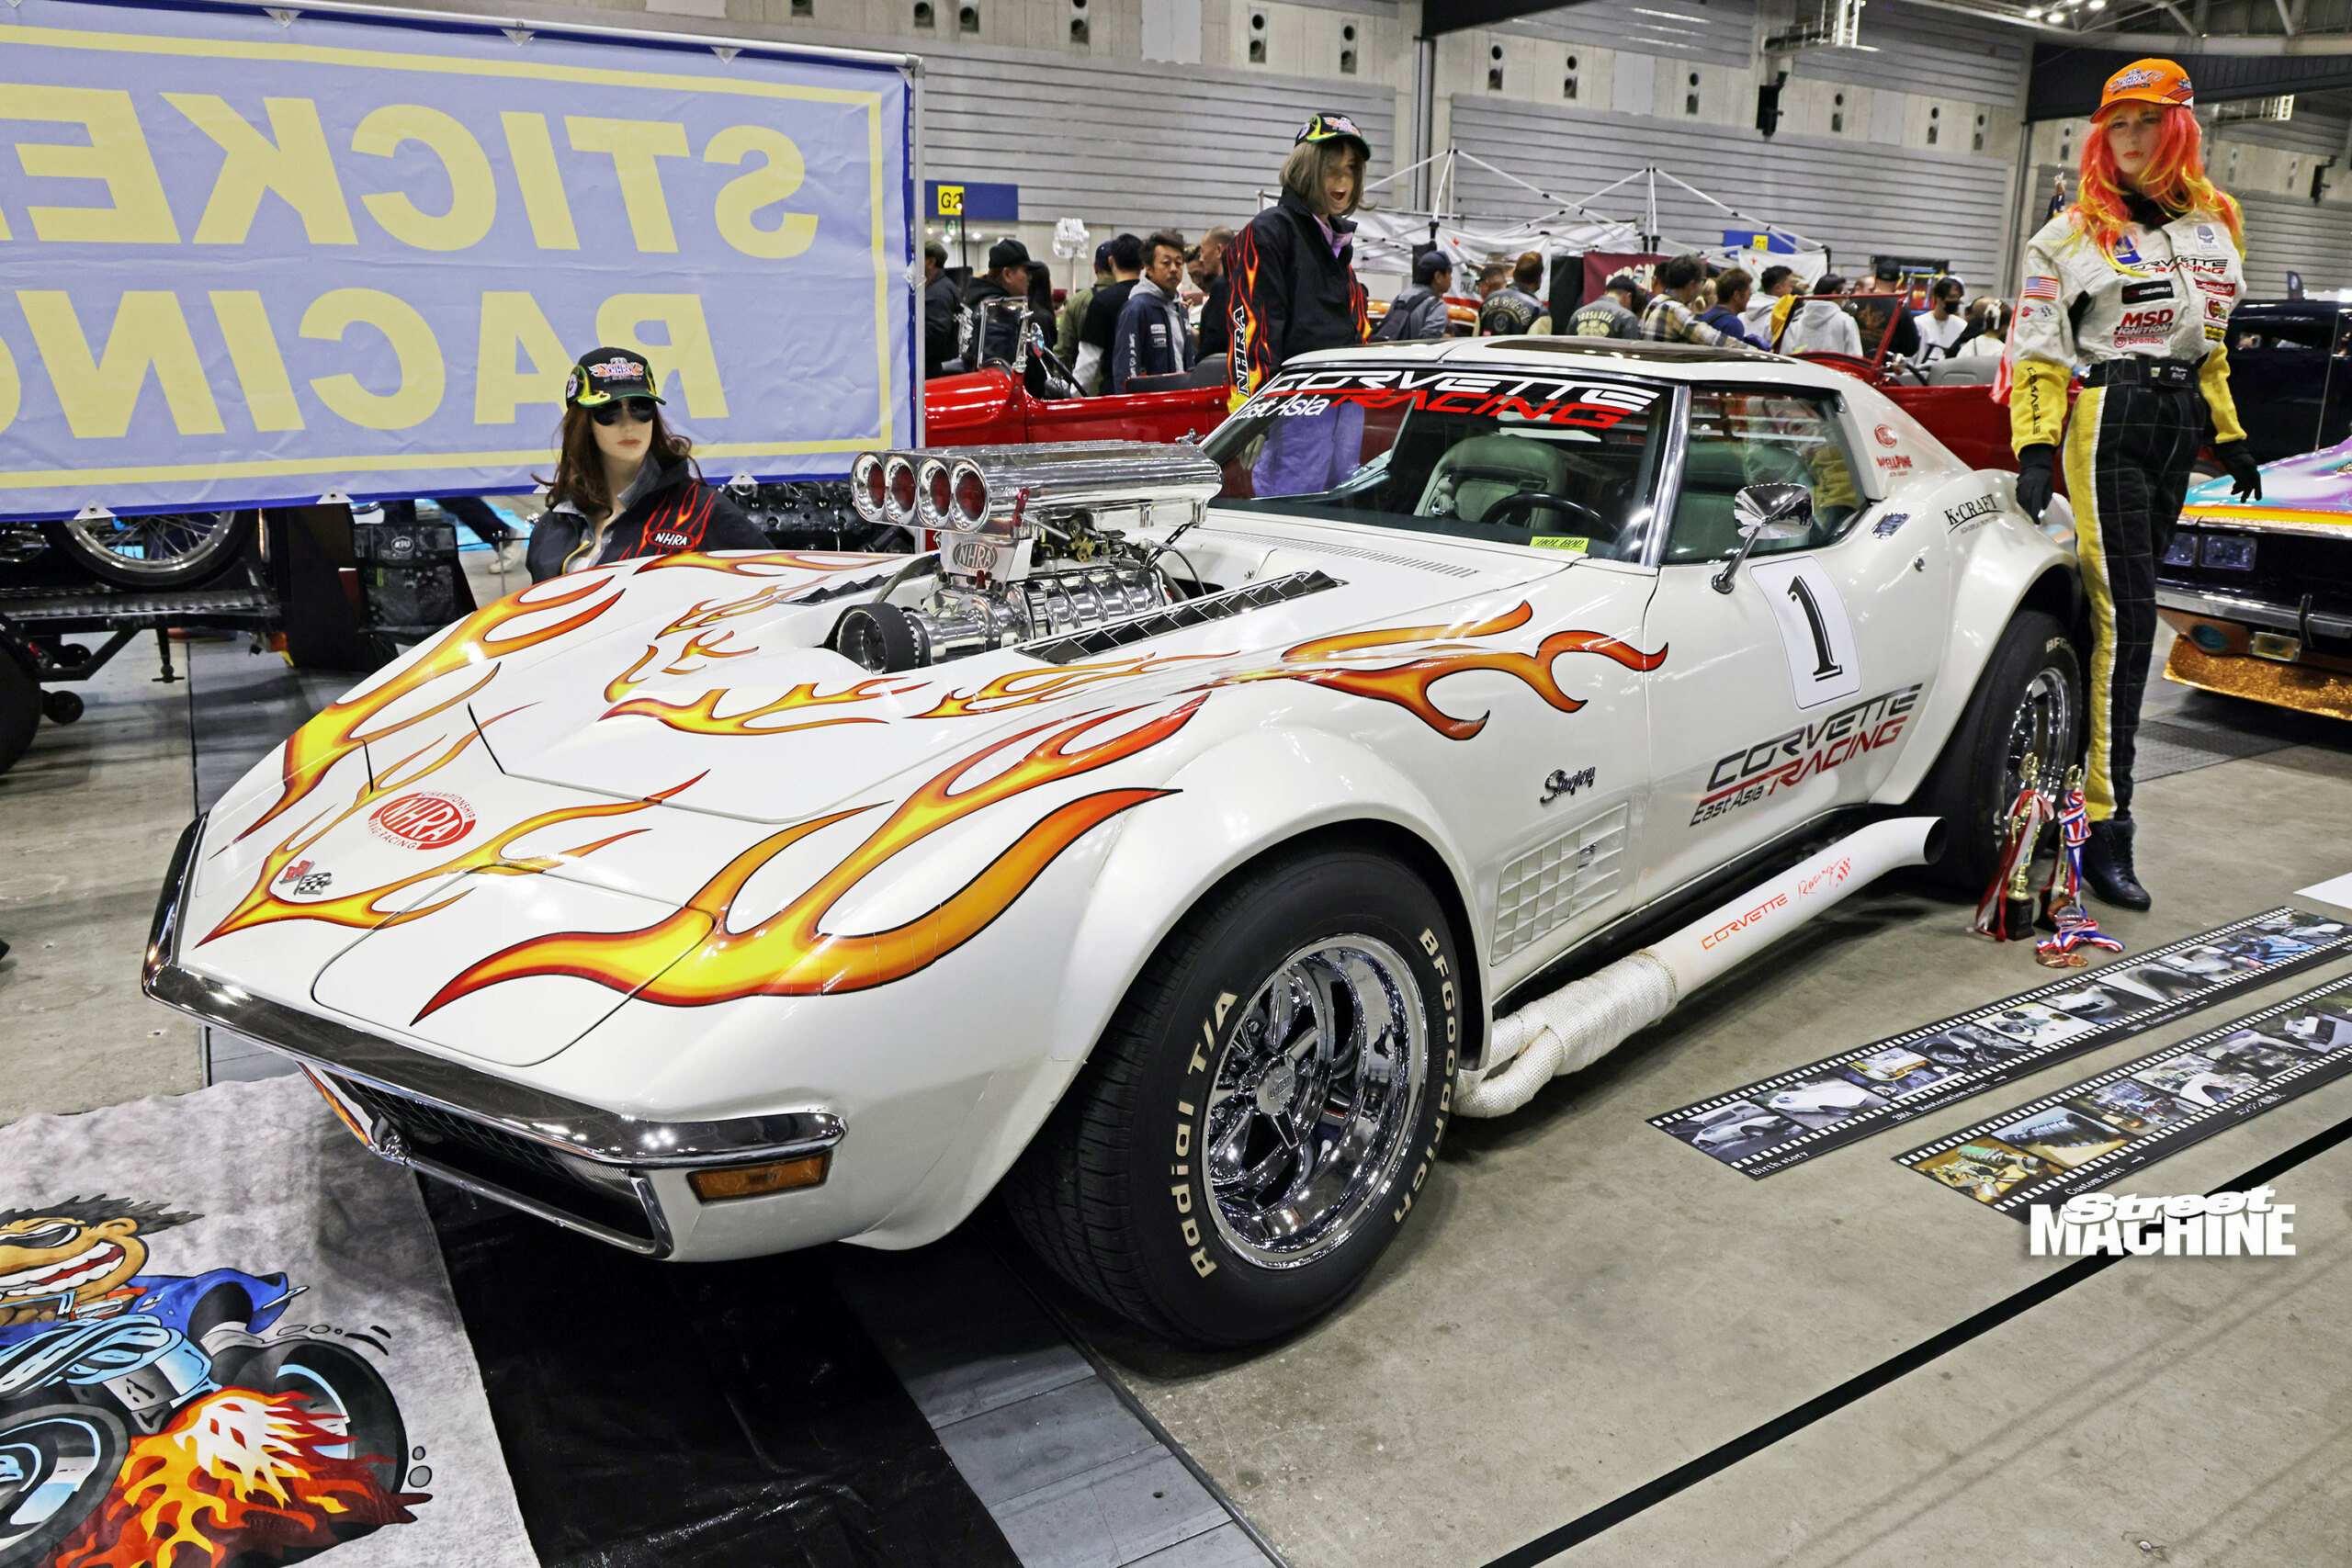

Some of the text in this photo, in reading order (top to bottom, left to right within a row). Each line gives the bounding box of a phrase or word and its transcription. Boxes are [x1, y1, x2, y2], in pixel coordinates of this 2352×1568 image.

[2116, 323, 2171, 336] IGNITION
[2120, 309, 2175, 328] MSD
[1233, 305, 1250, 397] NHRA
[2128, 336, 2164, 345] brembo
[1264, 371, 1660, 412] CORVETTE
[1266, 392, 1330, 417] Asia
[1331, 389, 1632, 429] RACING
[654, 533, 688, 547] NHRA
[958, 544, 991, 569] NHRA
[1787, 575, 1843, 682] 1
[1707, 683, 1924, 792] CORVETTE
[1764, 715, 1908, 797] RACING
[382, 797, 460, 841] NHRA
[1690, 782, 1765, 827] East Asia
[378, 830, 418, 850] RACING
[1702, 893, 1788, 950] CORVETTE
[1171, 991, 1238, 1279] Radial T/A
[1748, 1151, 1809, 1176] Birth story
[2064, 1167, 2126, 1195] Custom start
